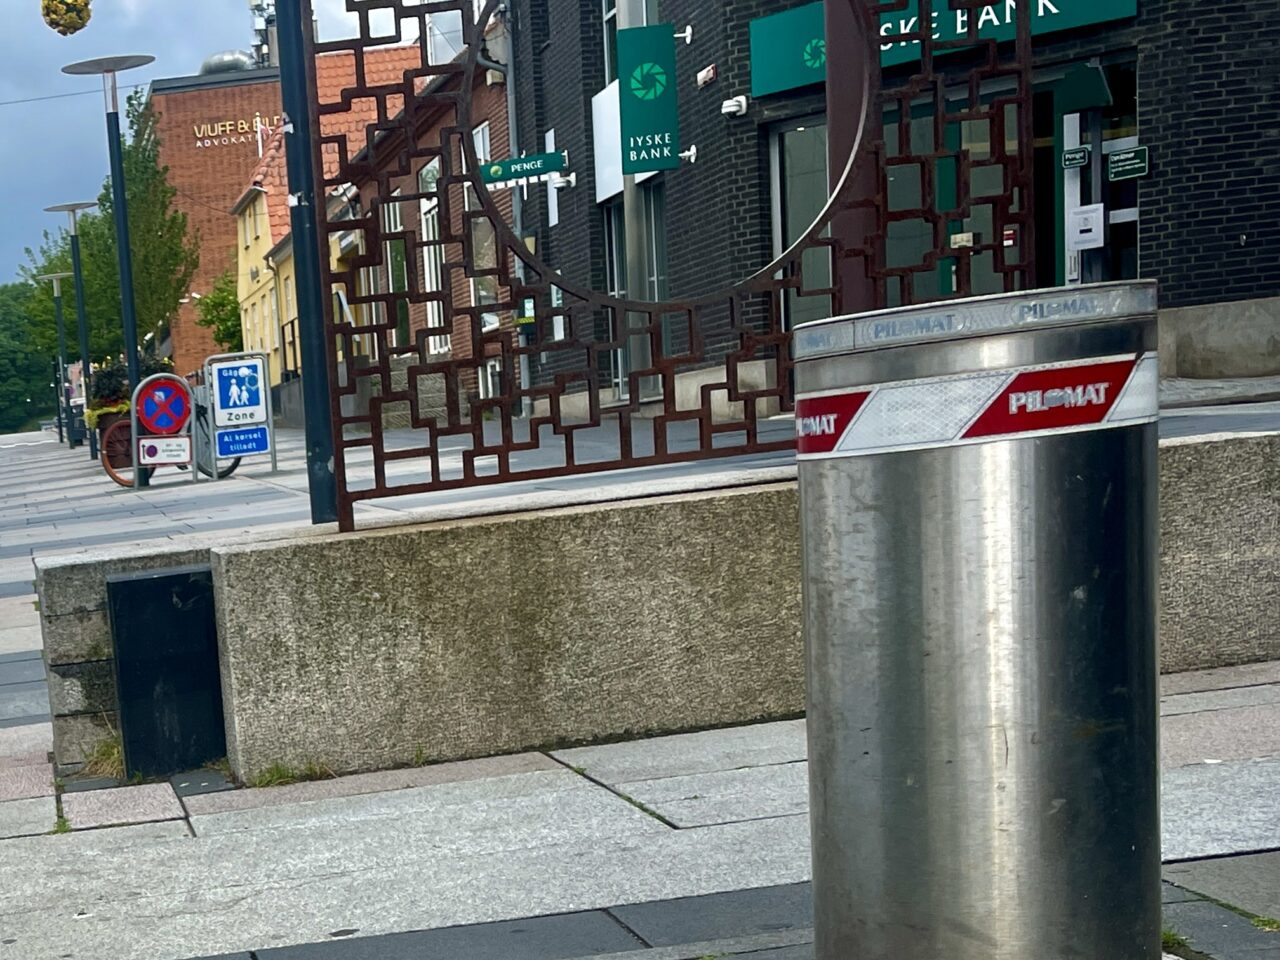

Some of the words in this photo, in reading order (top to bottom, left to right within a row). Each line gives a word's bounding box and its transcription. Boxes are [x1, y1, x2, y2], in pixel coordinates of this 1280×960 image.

[193, 121, 235, 138] VIUFF
[237, 119, 250, 133] &
[196, 134, 258, 148] ADVOKAT
[630, 146, 672, 161] BANK
[511, 160, 544, 173] PENGE
[1008, 381, 1111, 415] PILOMAT
[227, 411, 255, 421] Zone
[235, 432, 262, 441] kørsel
[230, 442, 257, 452] tilladt
